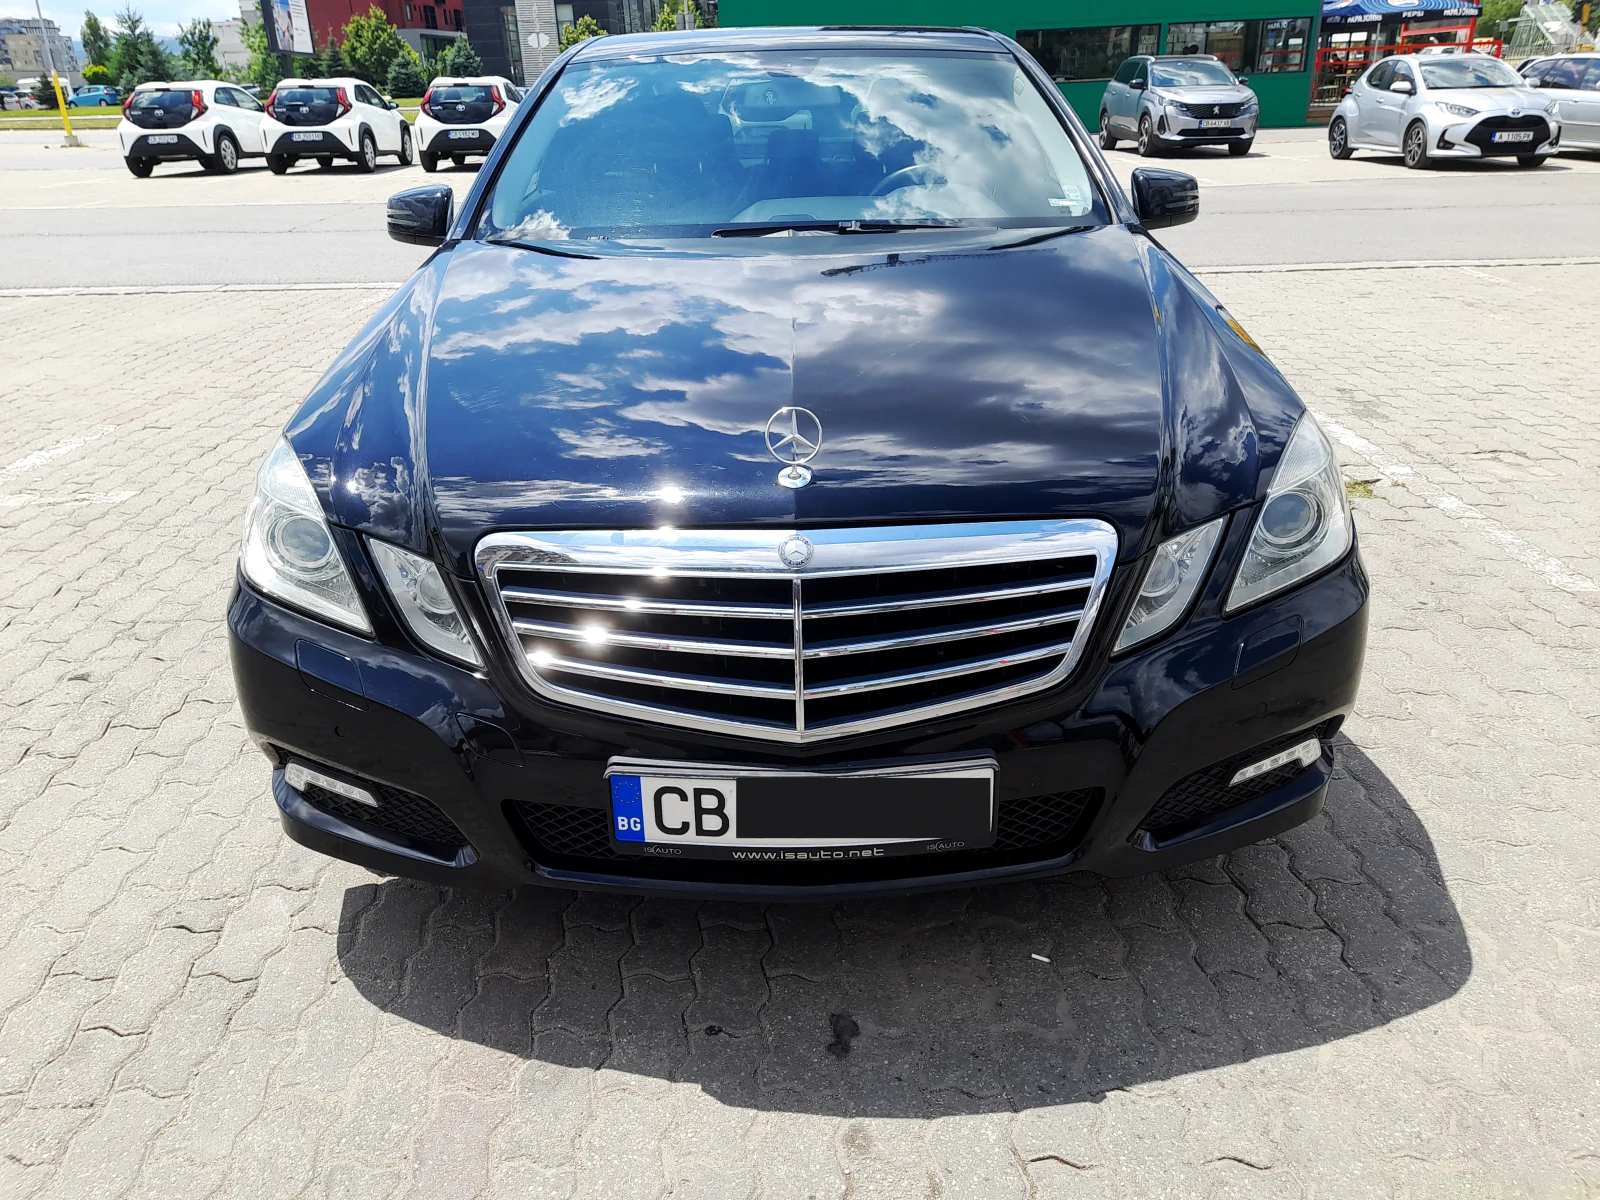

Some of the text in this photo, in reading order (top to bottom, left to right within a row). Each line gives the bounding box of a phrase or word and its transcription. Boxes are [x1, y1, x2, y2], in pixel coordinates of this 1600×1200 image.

[1402, 10, 1424, 18] PEPSI
[653, 786, 729, 837] CB
[617, 816, 641, 831] BG
[732, 847, 884, 860] www.isauto.net
